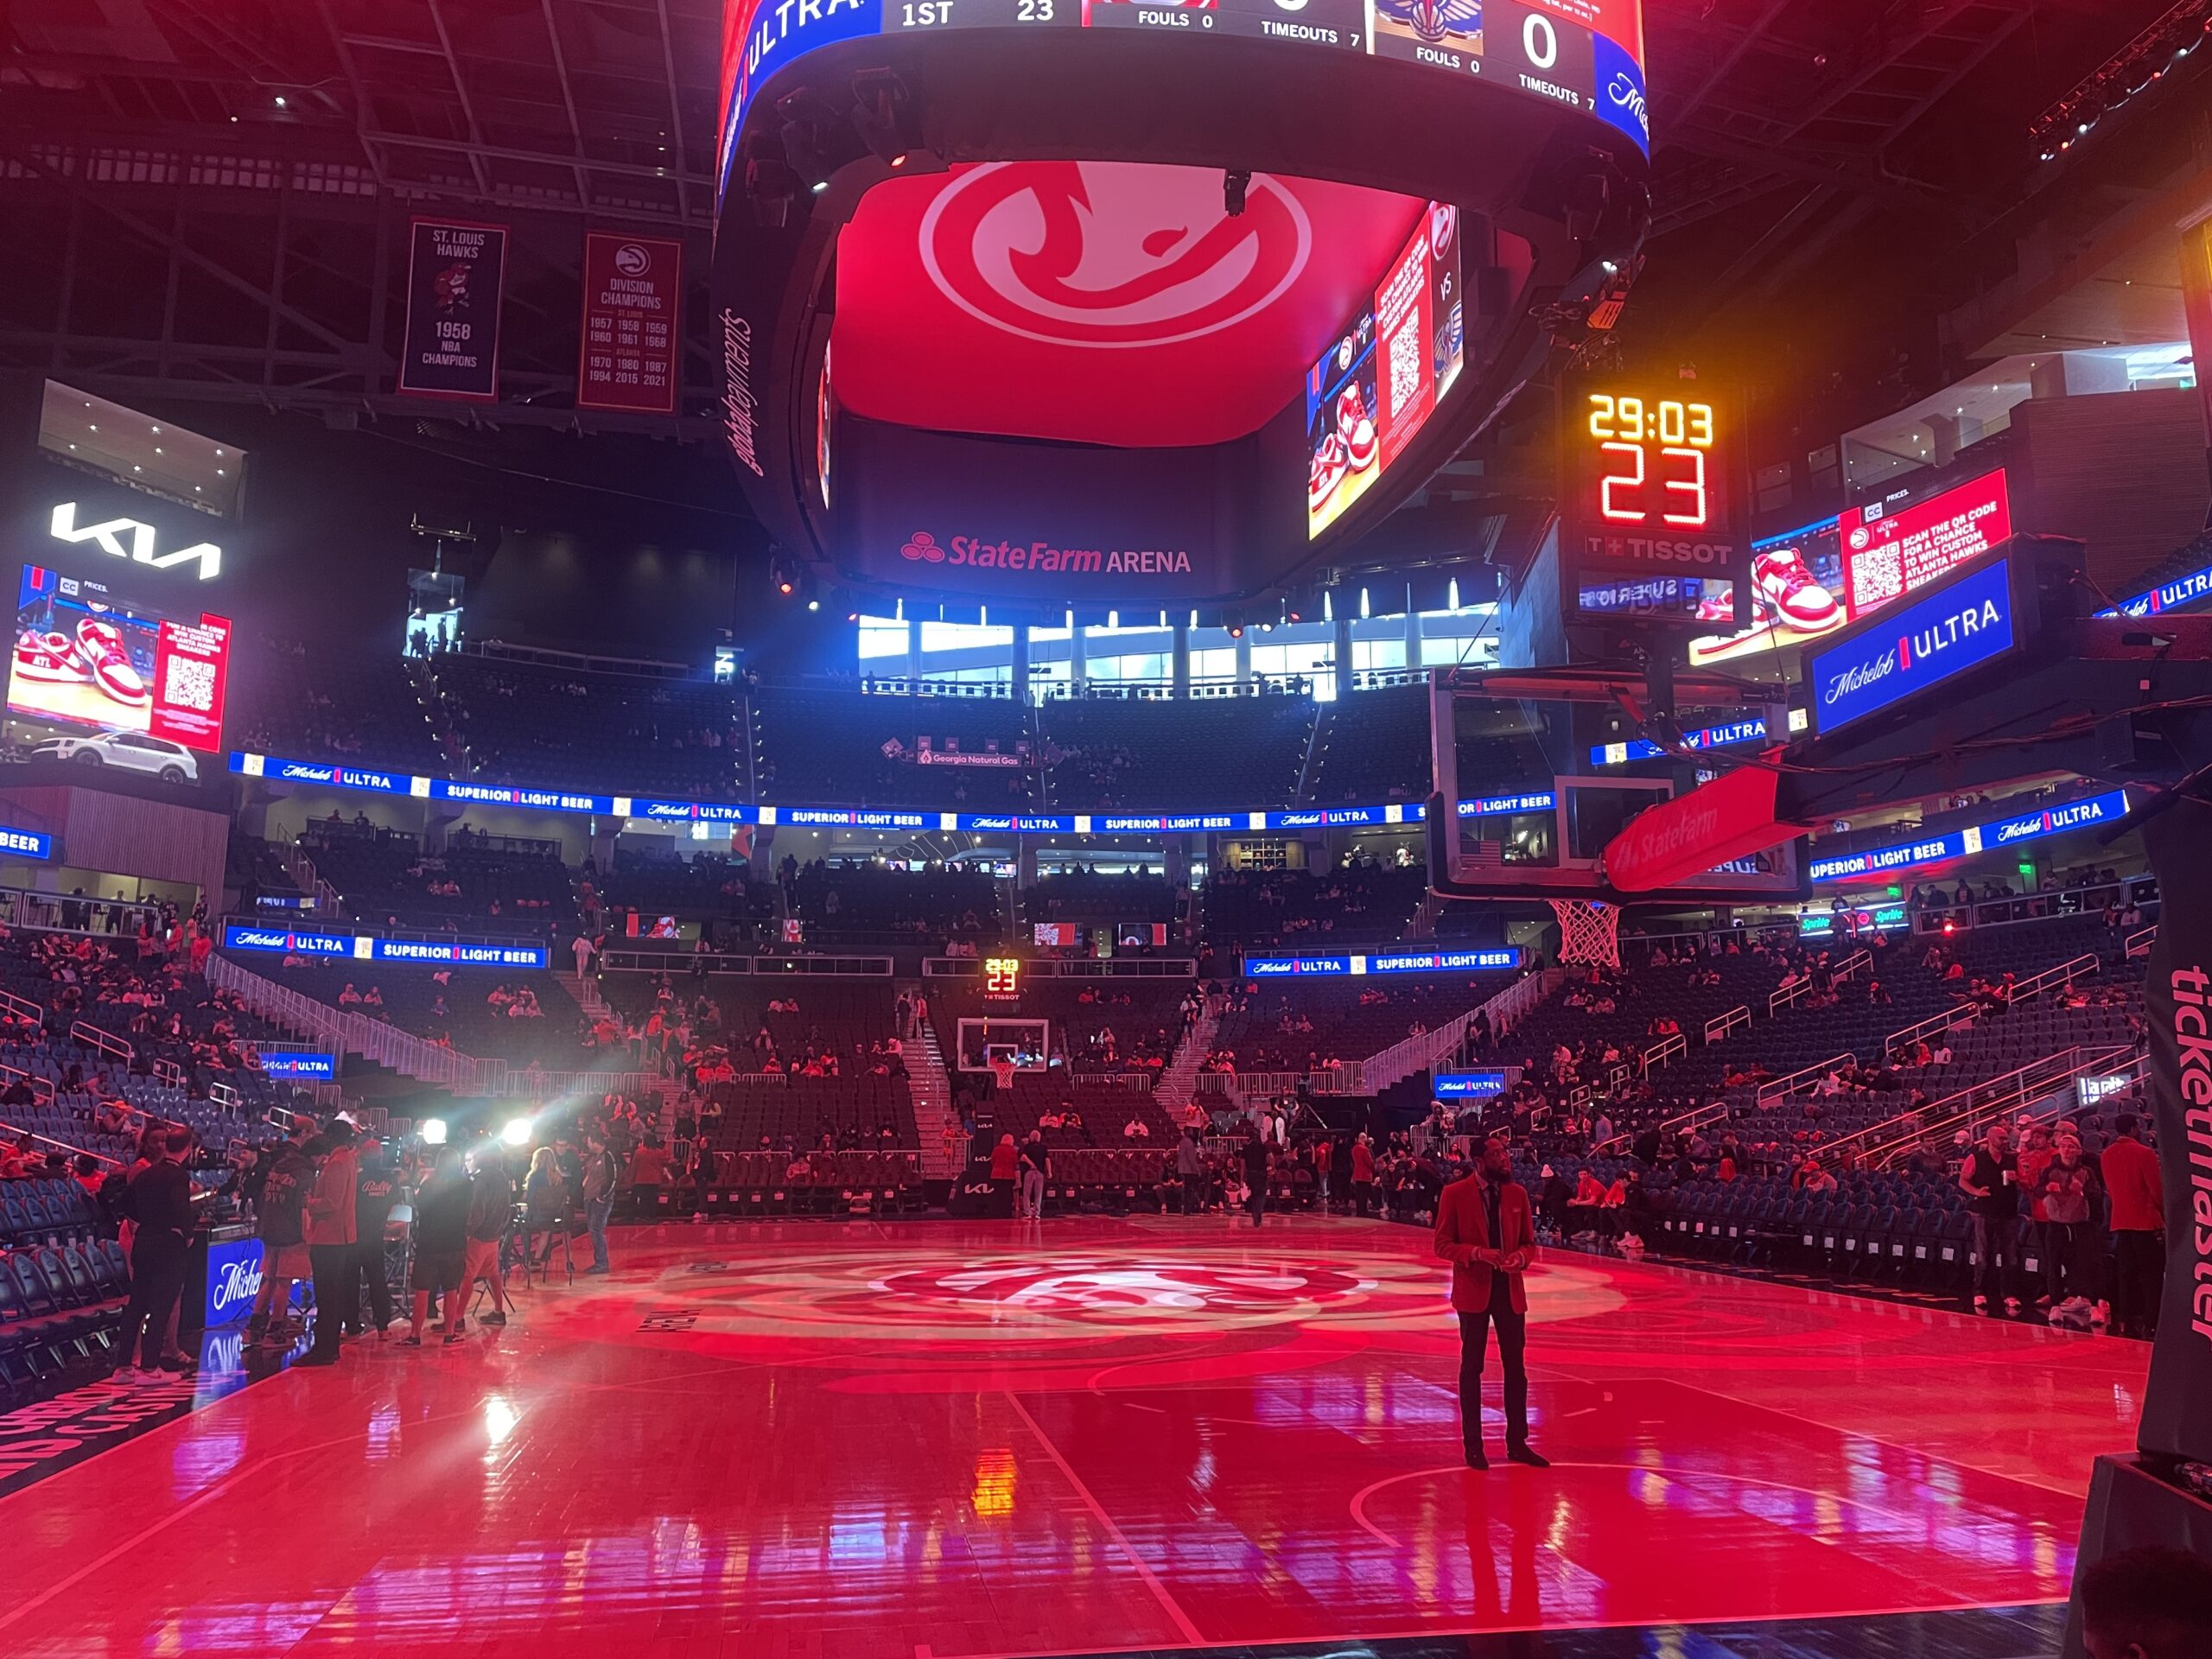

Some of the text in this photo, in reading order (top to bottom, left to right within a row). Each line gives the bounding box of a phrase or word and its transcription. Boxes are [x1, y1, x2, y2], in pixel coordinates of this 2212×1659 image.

[902, 0, 1054, 27] 1ST 23
[1138, 10, 1213, 29] FOULS 0
[1261, 21, 1360, 48] TIMEOUTS 7
[1522, 13, 1557, 69] 0
[1416, 47, 1480, 73] FOULS 0
[1518, 73, 1596, 111] TIMEOUTS 7
[433, 230, 485, 246] ST. LOUIS
[436, 243, 479, 258] HAWKS
[610, 278, 654, 295] DIVISION
[1440, 271, 1452, 301] VS
[601, 292, 662, 309] CHAMPIONS
[435, 321, 471, 340] 1958
[591, 316, 612, 329] 1957
[645, 322, 667, 334] 1959
[442, 340, 461, 353] NBA
[590, 331, 666, 347] 1960 1961 1968
[422, 353, 478, 367] CHAMPIONS
[590, 356, 612, 368] 1970
[645, 360, 667, 373] 1987
[589, 370, 665, 386] 1994 2015 2021
[1589, 394, 1713, 447] 29:03
[1600, 442, 1707, 525] 23
[1867, 506, 1881, 518] CC
[1903, 501, 1997, 548] SCAN THE QR CODE
[51, 501, 221, 581] KIA
[1904, 522, 1975, 558] FOR A CHANCE
[1627, 538, 1732, 564] TISSOT
[1904, 531, 1982, 569] TO WIN CUSTOM
[1106, 551, 1192, 573] ARENA
[1905, 540, 1988, 580] ATLANTA HAWKS
[1906, 563, 1957, 590] SNEAK
[62, 582, 76, 592] CC
[2162, 570, 2212, 605] ULTR
[1825, 600, 1999, 704] Michelob ULTRA
[1713, 721, 1766, 743] ULTRA
[933, 754, 1018, 765] Georgia Natural Gas
[283, 765, 391, 789] Michelob ULTRA
[447, 785, 593, 810] SUPERIOR LIGHT BEER
[1484, 798, 1518, 812] LIGHT
[1521, 795, 1552, 808] BEER
[700, 805, 741, 819] ULTRA
[791, 811, 923, 826] SUPERIOR LIGHT BEER
[1329, 810, 1369, 823] ULTRA
[1020, 819, 1058, 830] ULTRA
[1105, 817, 1230, 830] SUPERIOR LIGHT BEER
[1998, 802, 2103, 842] Michelob ULTRA
[0, 831, 40, 852] BEER
[1809, 842, 1946, 879] UPERIOR LIGHT BEER
[1802, 917, 1830, 931] Sprite
[1875, 909, 1904, 922] Sprite
[236, 931, 344, 952] Michelob ULTRA
[384, 944, 537, 963] SUPERIOR LIGHT BEER
[1376, 953, 1510, 969] SUPERIOR LIGHT BEER
[1301, 960, 1341, 971] ULTRA
[988, 971, 1016, 991] 23
[297, 1062, 329, 1071] ULTRA
[213, 1258, 263, 1311] Miche
